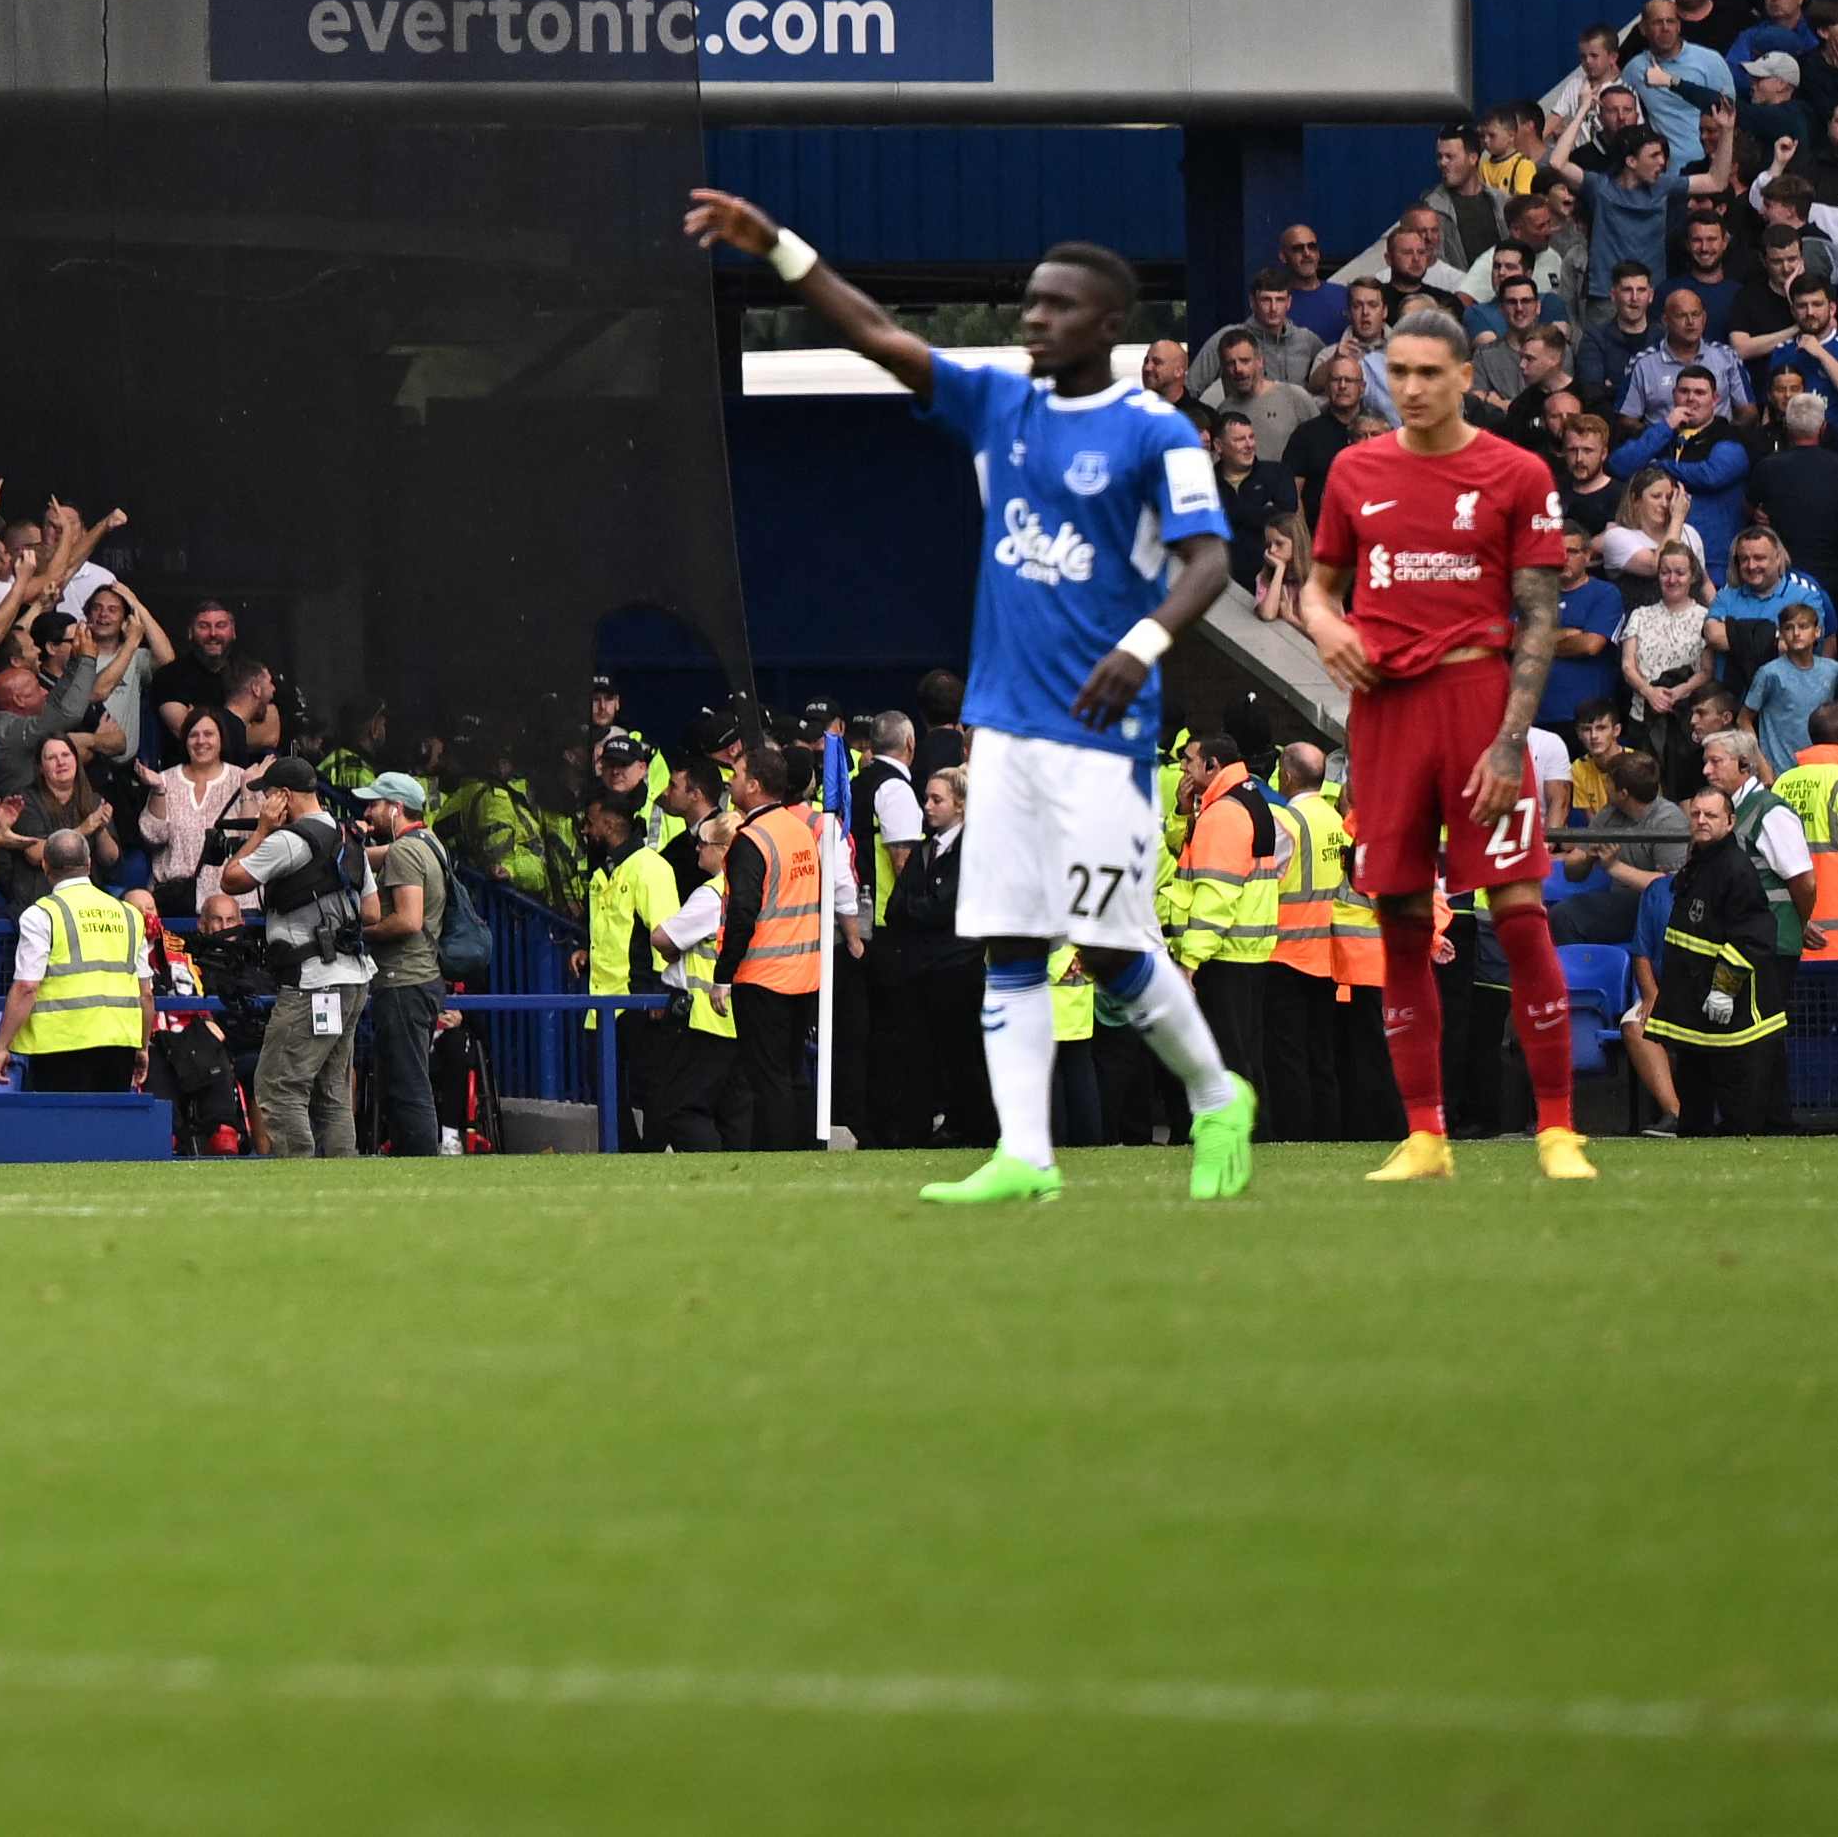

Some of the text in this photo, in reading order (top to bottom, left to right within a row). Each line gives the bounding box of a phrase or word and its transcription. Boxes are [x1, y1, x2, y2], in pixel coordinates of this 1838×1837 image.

[1393, 550, 1476, 568] standard
[1393, 564, 1483, 582] chartered
[1067, 864, 1125, 919] 27
